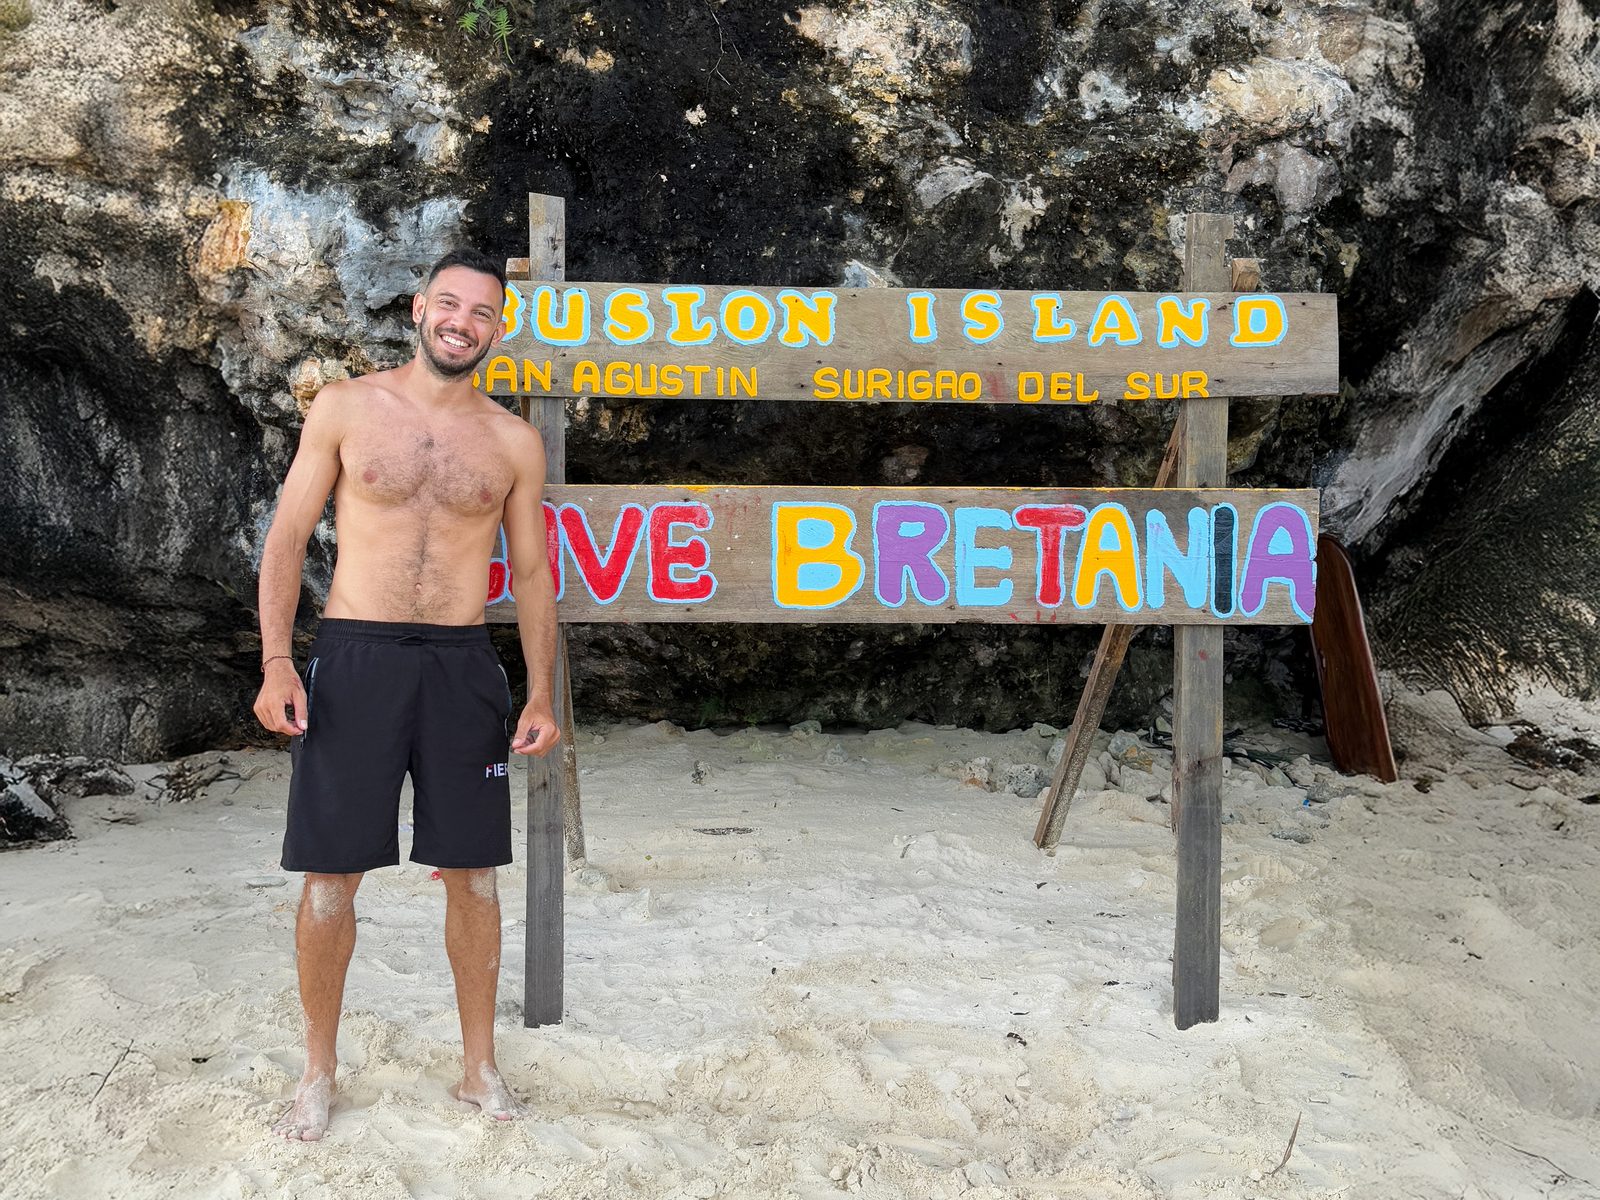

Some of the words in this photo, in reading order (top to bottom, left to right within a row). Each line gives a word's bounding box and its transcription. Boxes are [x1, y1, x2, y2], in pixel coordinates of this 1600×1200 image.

[907, 290, 1288, 347] ISLAND
[473, 356, 552, 392] AN
[573, 360, 758, 397] AGUSTIN
[813, 367, 982, 402] SURIGAO
[1018, 371, 1099, 402] DEL
[1124, 369, 1210, 400] SUR
[772, 501, 1316, 623] BRETANIA
